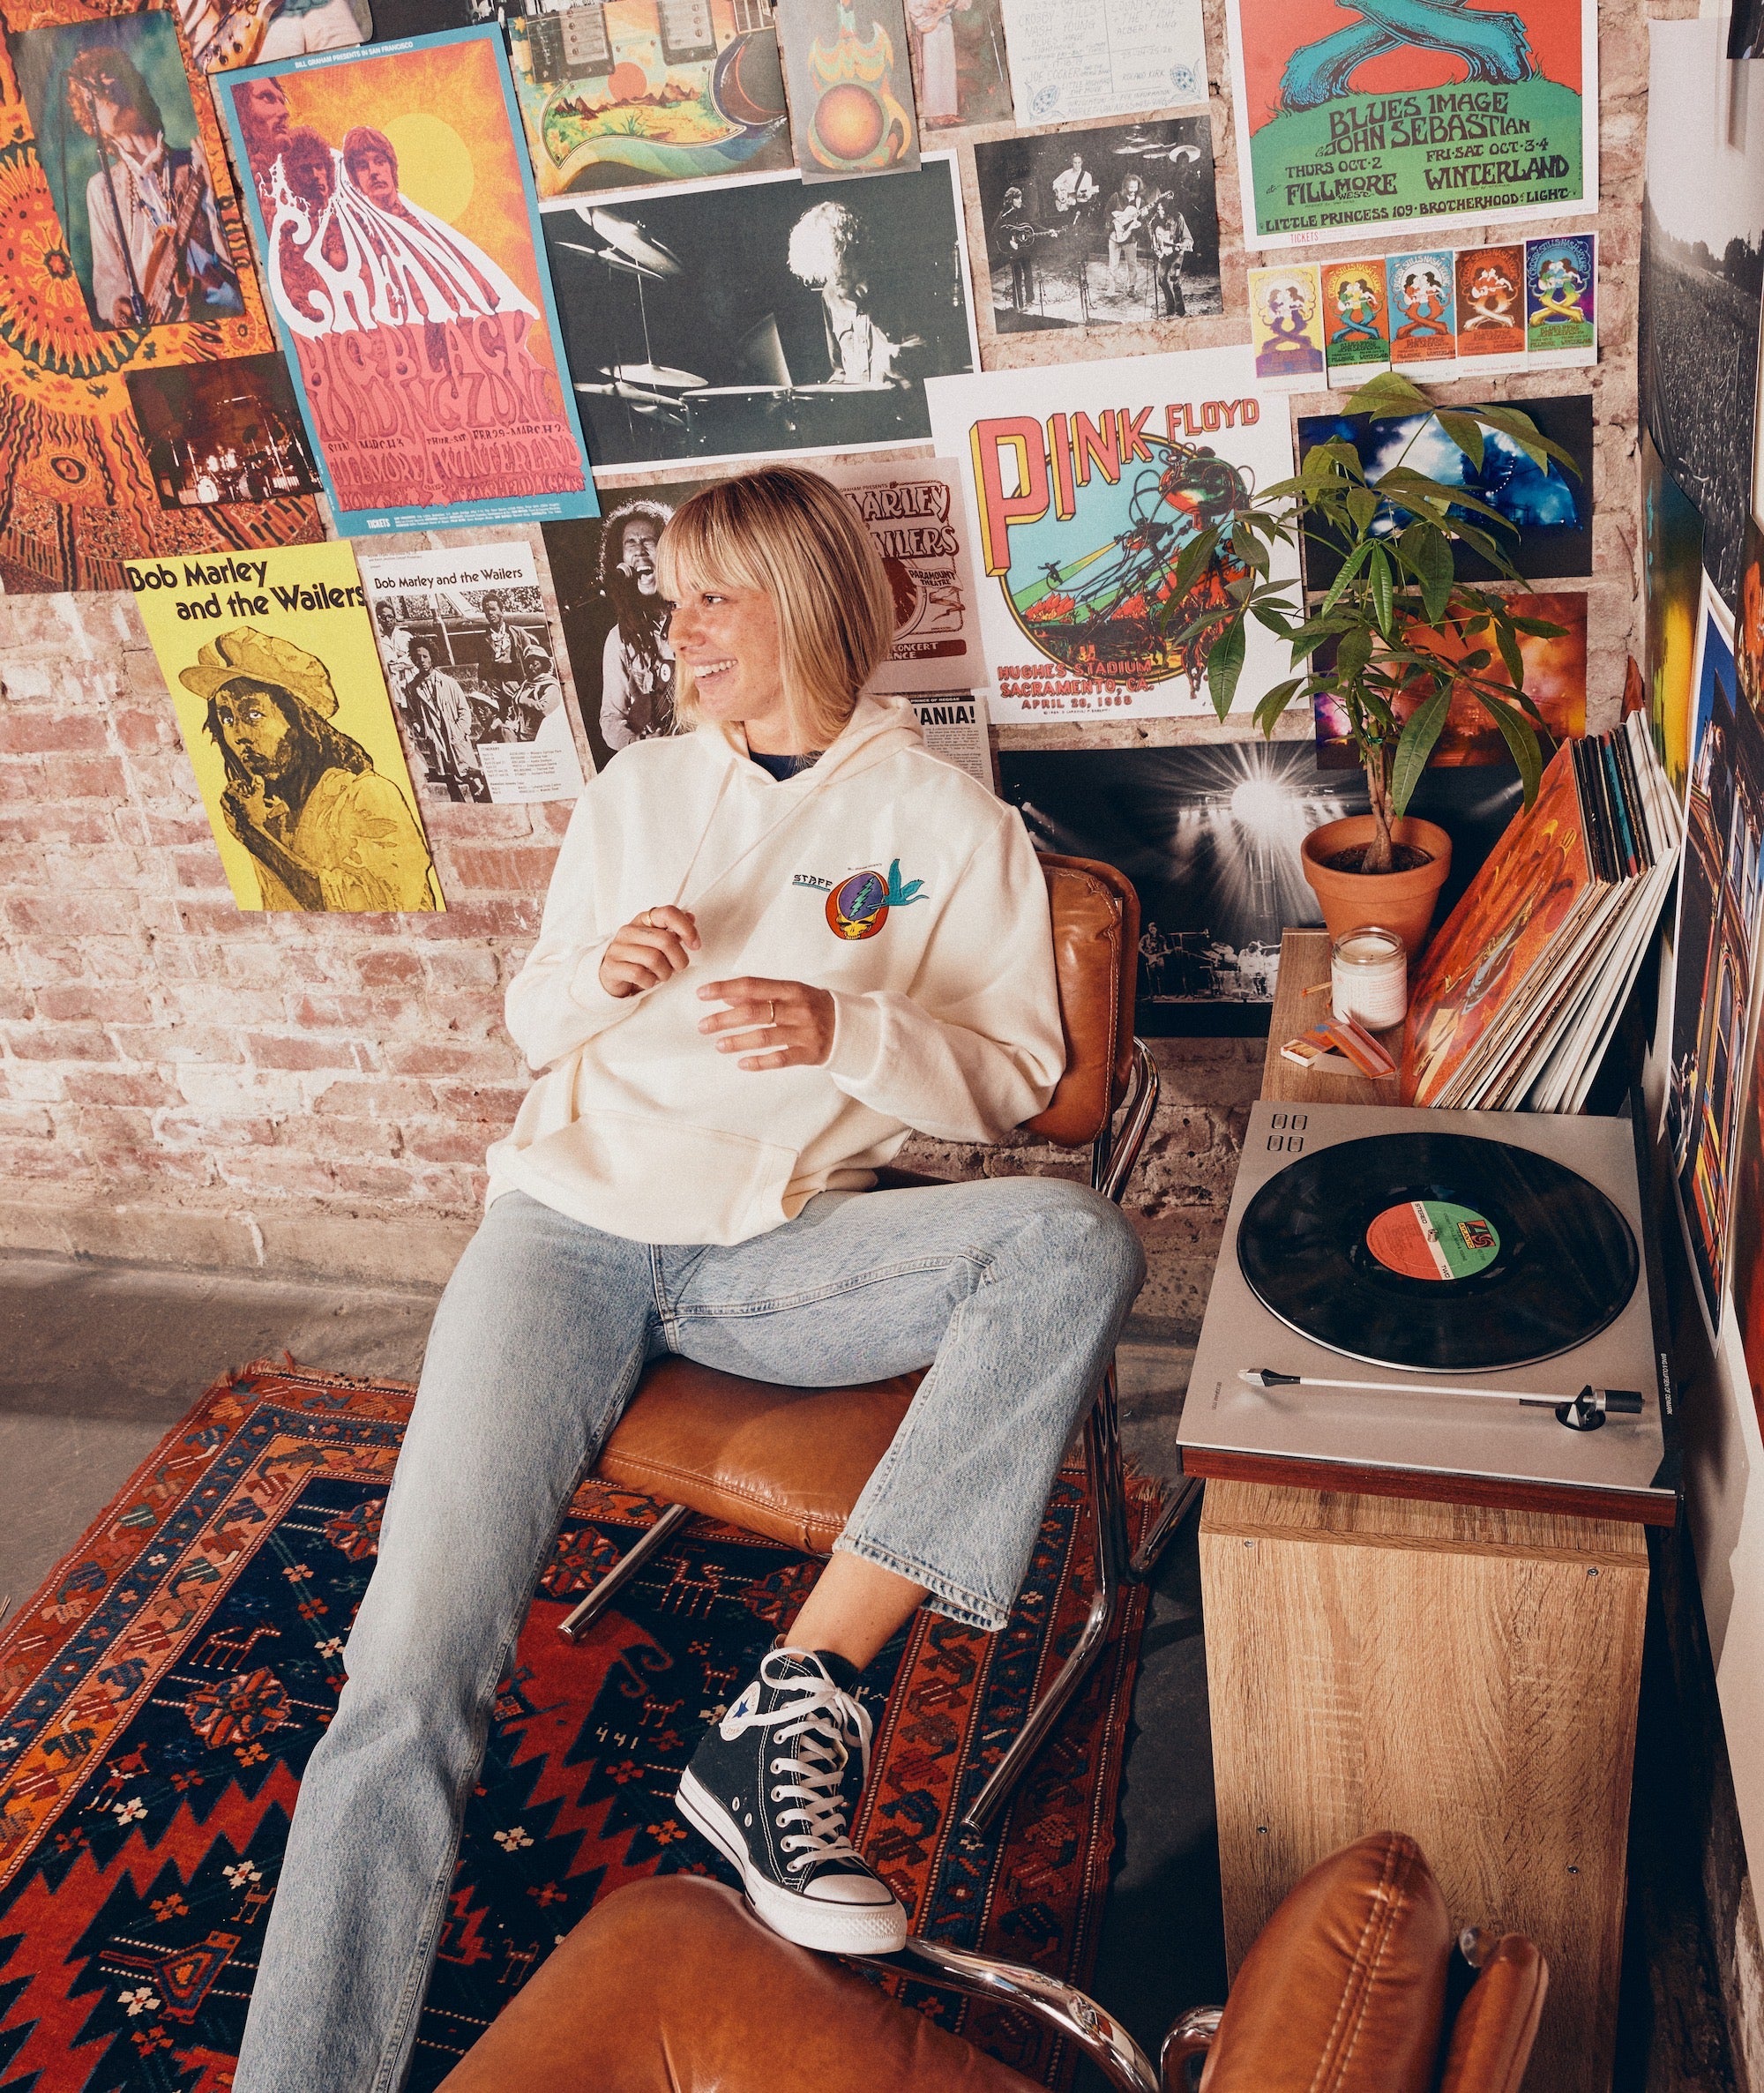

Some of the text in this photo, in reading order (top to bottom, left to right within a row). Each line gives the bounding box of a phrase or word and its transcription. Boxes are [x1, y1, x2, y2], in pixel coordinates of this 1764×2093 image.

[295, 60, 307, 69] BILL
[308, 55, 332, 66] GRAHAM
[333, 50, 362, 62] PRESENTS
[368, 46, 381, 55] SAN
[381, 41, 414, 53] FRANCISCO
[1328, 92, 1509, 138] BLUES IMAGE
[1323, 123, 1386, 156] JOHN
[1390, 113, 1530, 149] SEBASTIAN
[1285, 161, 1334, 178] THURS
[1423, 154, 1570, 191] WINTERLAND
[1284, 173, 1398, 206] FILLMORE
[1337, 191, 1374, 201] WEST
[1266, 215, 1318, 232] LITTLE
[1320, 207, 1389, 227] PRINCESS
[1420, 193, 1519, 215] BROTHERHOOD
[1527, 188, 1569, 203] LIGHT
[1290, 231, 1319, 243] TICKETS
[267, 196, 541, 341] CREAM
[377, 310, 547, 381] BLACK
[432, 437, 583, 479] WINTERLAND
[969, 398, 1260, 578] PINK FLOYD
[366, 519, 391, 529] TICKETS
[870, 526, 960, 559] AILERS
[126, 557, 267, 592] Bob Marley
[374, 567, 522, 589] Bob Marley and the Wailers
[908, 570, 956, 580] PARAMOUNT
[176, 583, 367, 620] and the Wailers
[893, 642, 938, 652] CONCERT
[998, 660, 1153, 681] HUGHES STADIUM
[1000, 676, 1155, 698] SACRAMENTO, CA.
[914, 706, 975, 725] ANIA!
[1021, 699, 1065, 710] APRIL
[794, 874, 833, 888] STAFF
[1415, 1203, 1427, 1224] STEREO
[1460, 1223, 1474, 1249] ATLANTIC
[1442, 1265, 1451, 1279] TWO
